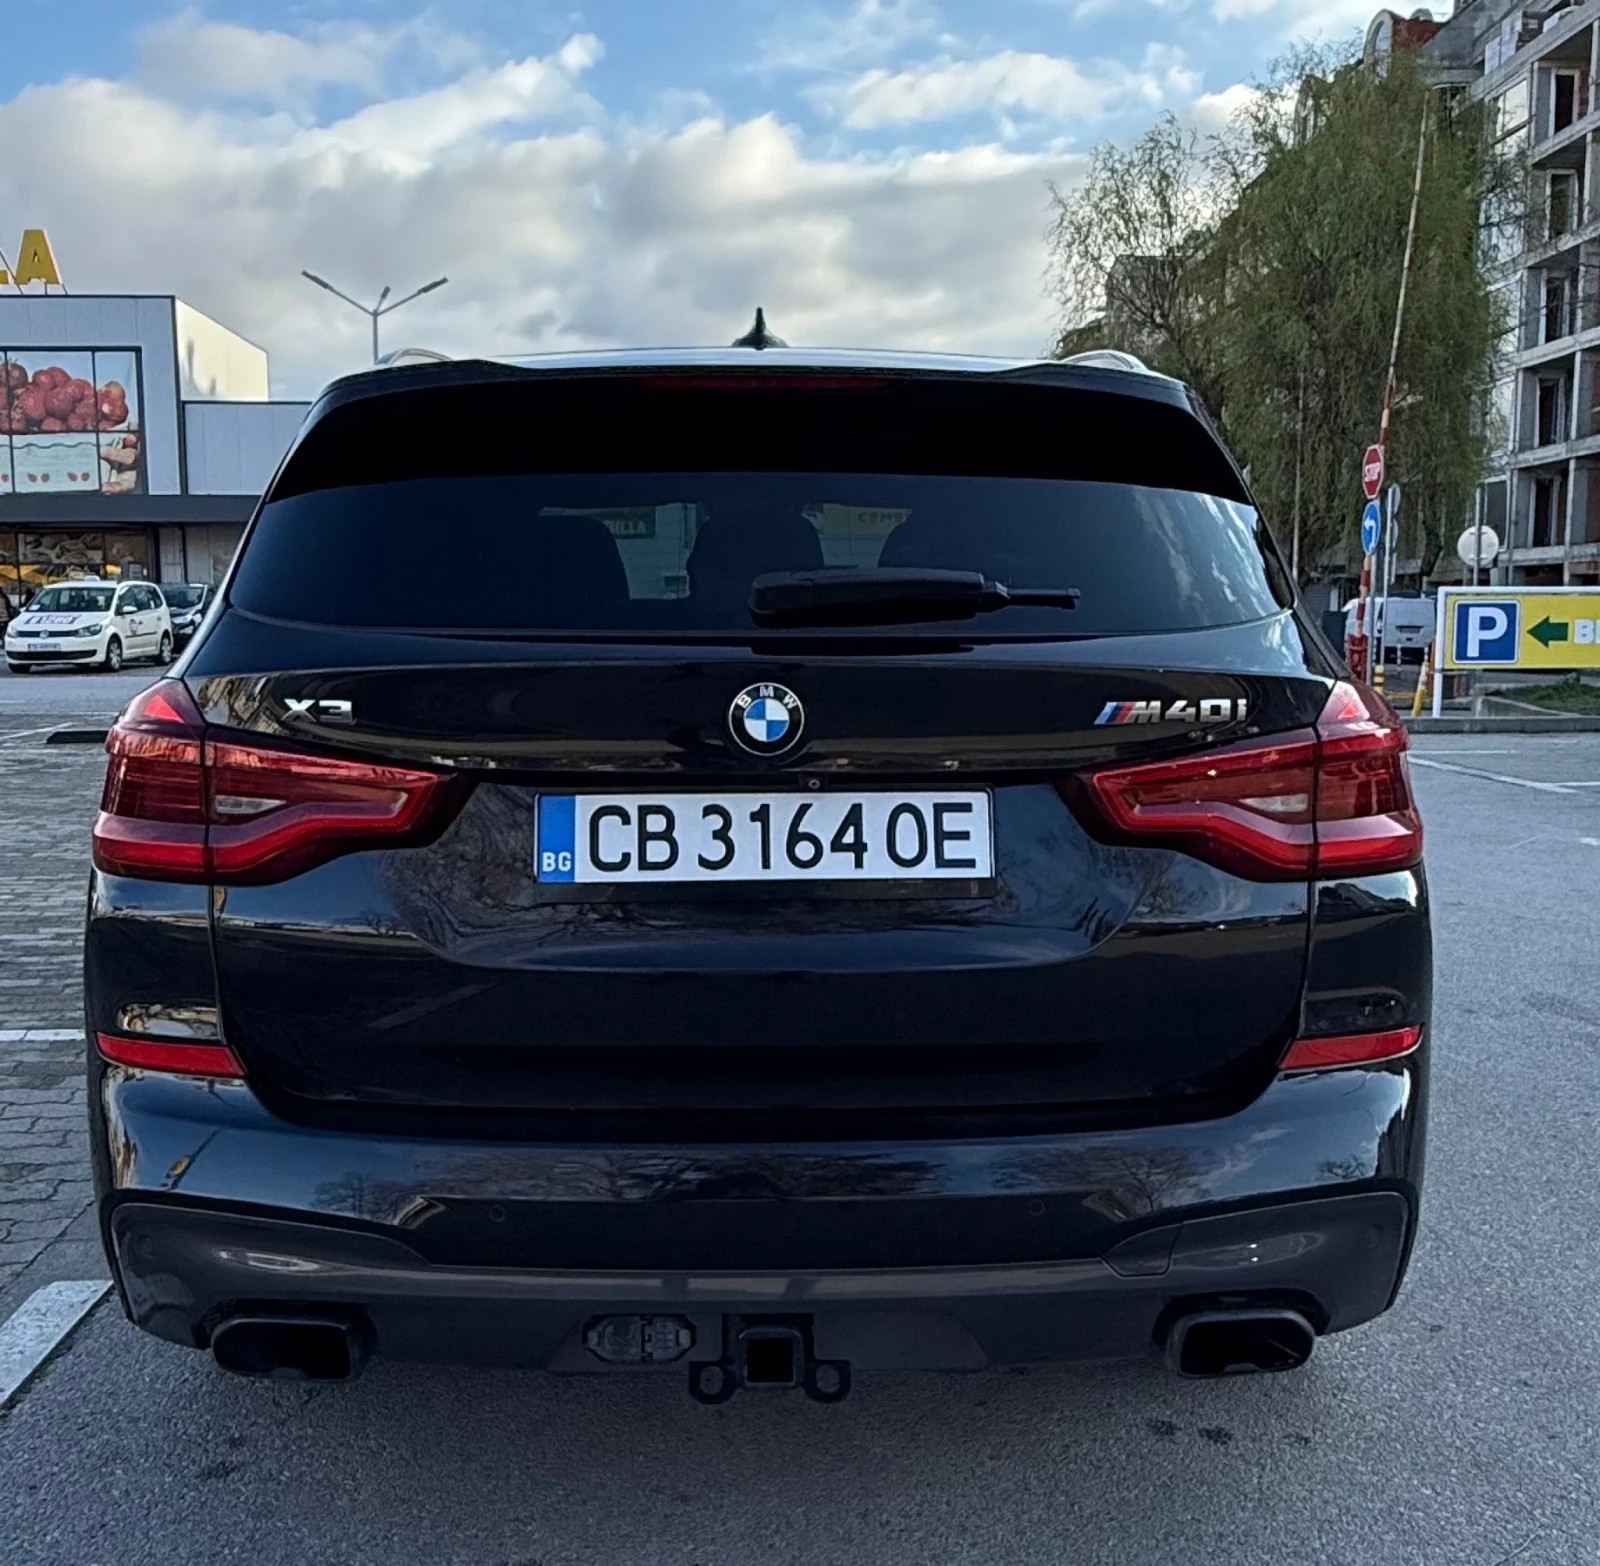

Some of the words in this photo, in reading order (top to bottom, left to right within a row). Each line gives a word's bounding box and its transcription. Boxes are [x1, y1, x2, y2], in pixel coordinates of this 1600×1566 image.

[0, 229, 62, 285] A
[1467, 606, 1508, 658] P
[1573, 618, 1600, 645] B
[737, 685, 798, 709] BMW
[281, 698, 354, 725] X3
[1123, 698, 1248, 724] M40i
[588, 803, 680, 873] CB
[697, 801, 869, 871] 3164
[885, 801, 977, 870] OE
[542, 852, 571, 873] BG
